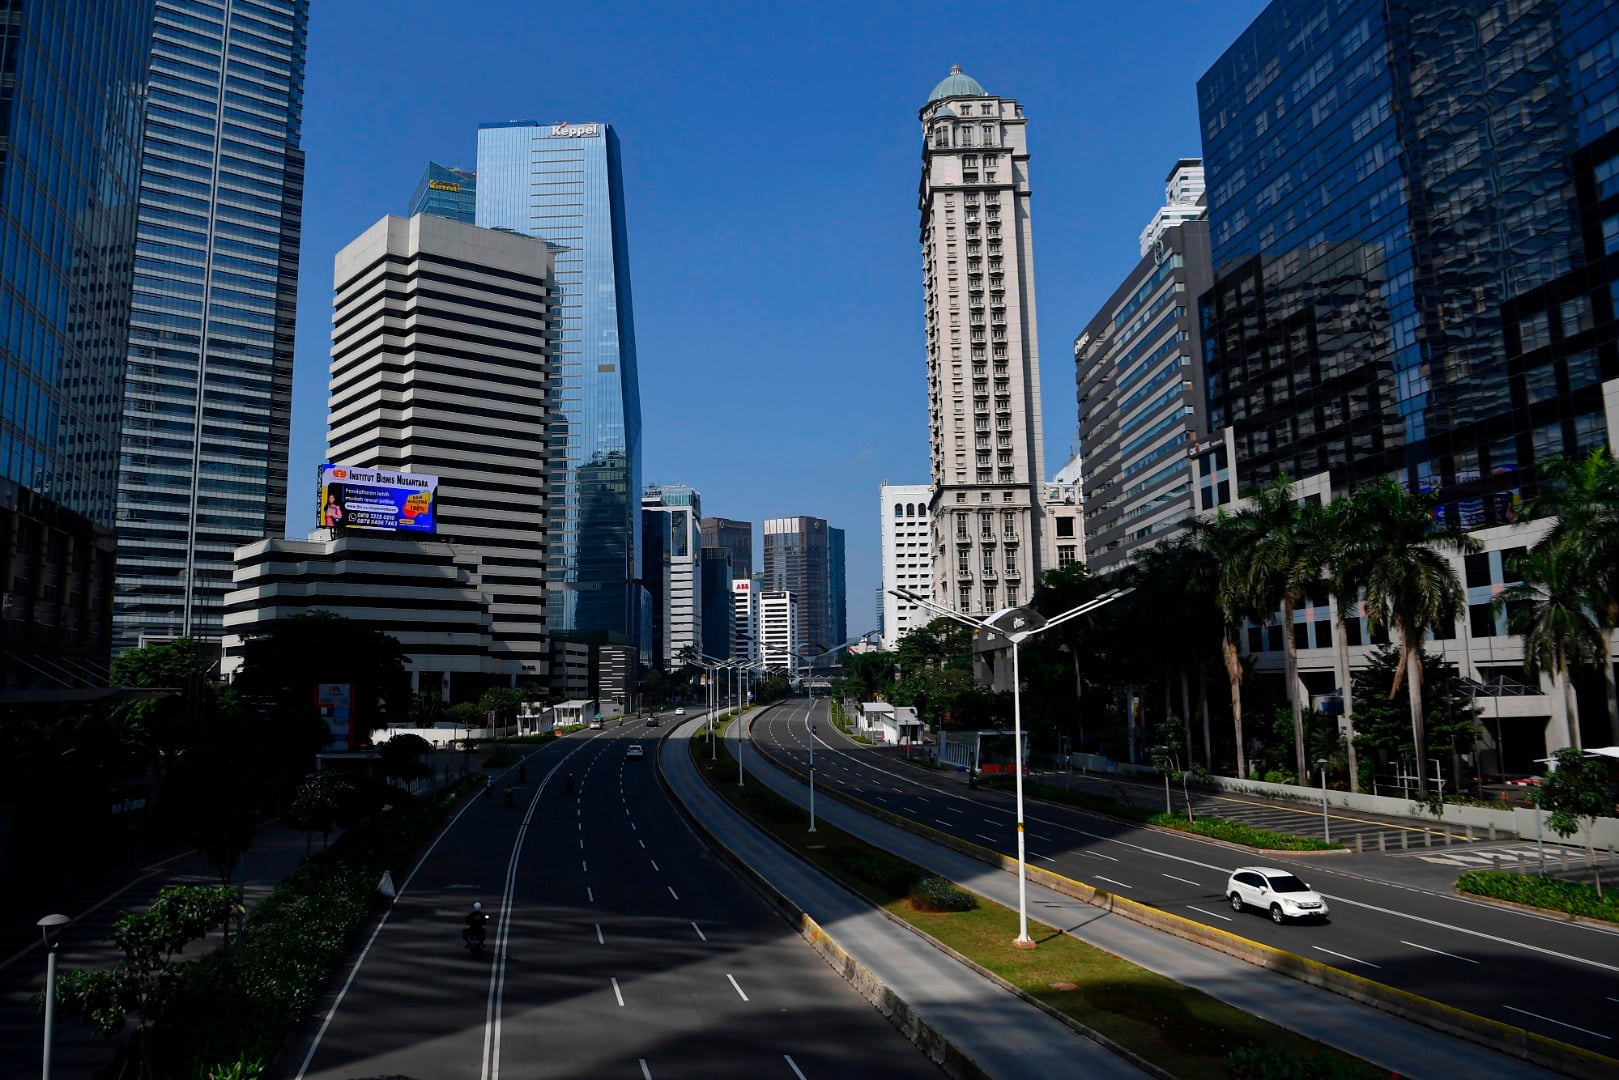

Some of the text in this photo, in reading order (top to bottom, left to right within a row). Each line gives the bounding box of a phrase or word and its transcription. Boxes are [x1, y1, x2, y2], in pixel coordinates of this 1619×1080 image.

[552, 124, 597, 137] Keppel
[349, 470, 429, 488] INSTITUT BISNIS NUSANTARA
